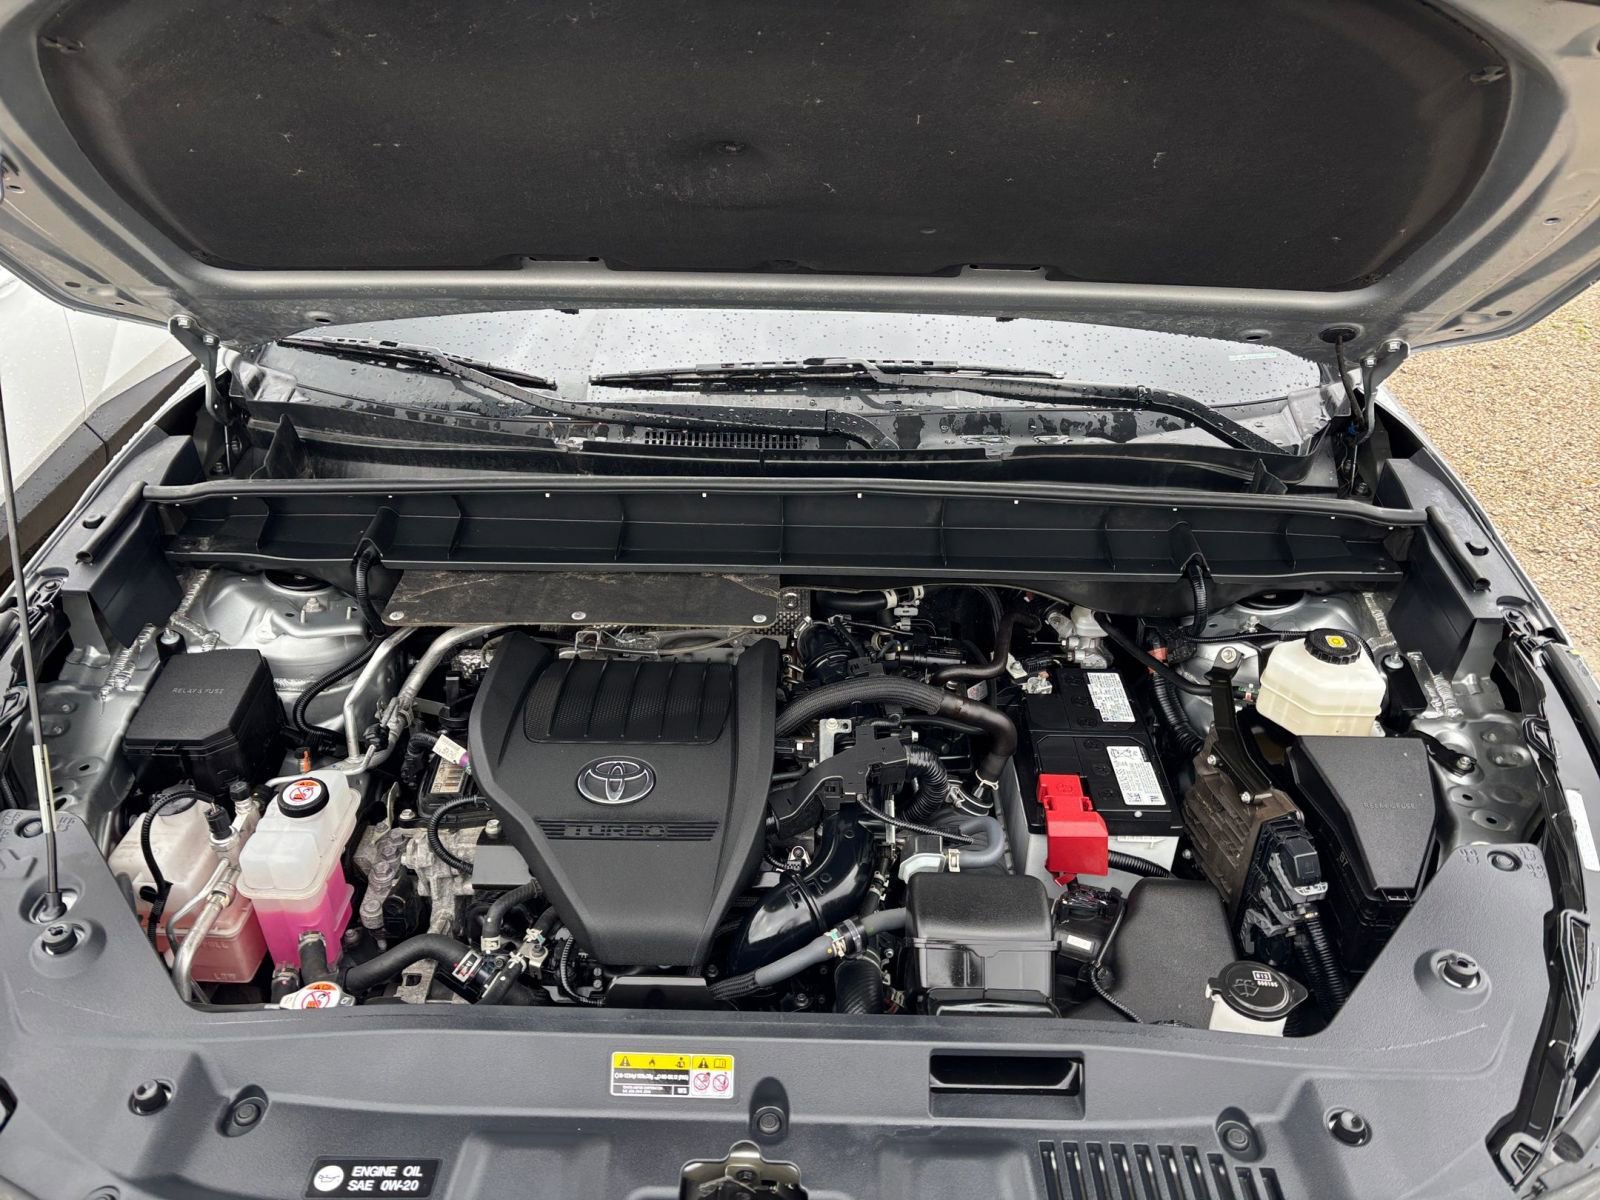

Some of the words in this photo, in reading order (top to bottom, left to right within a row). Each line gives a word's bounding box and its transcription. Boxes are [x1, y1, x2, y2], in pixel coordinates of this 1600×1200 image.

[567, 824, 665, 837] TURBO
[351, 1165, 398, 1177] ENGINE
[402, 1165, 423, 1177] OIL
[346, 1179, 375, 1191] SAE
[380, 1179, 419, 1191] 0W-20
